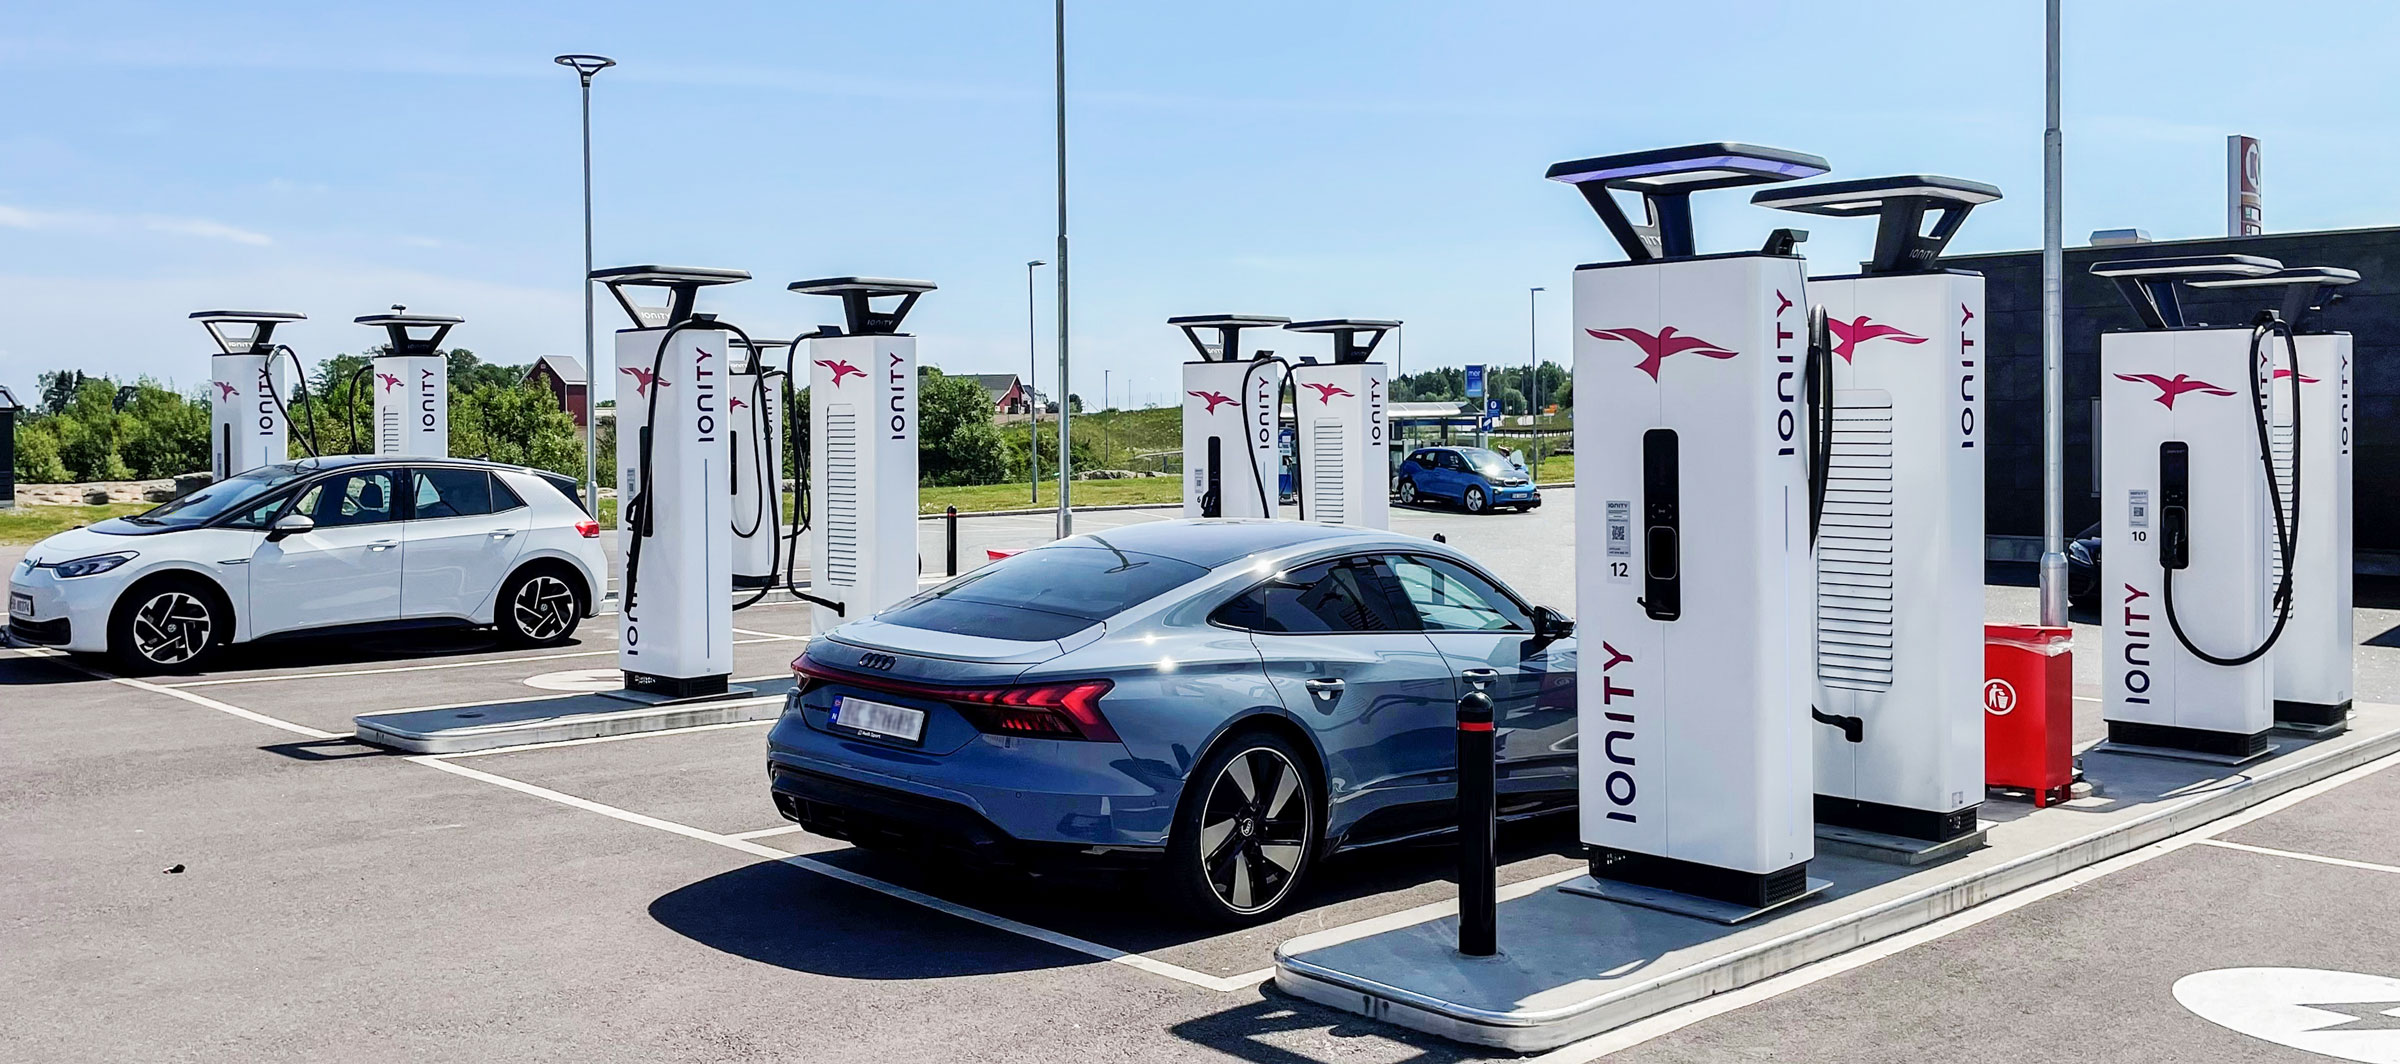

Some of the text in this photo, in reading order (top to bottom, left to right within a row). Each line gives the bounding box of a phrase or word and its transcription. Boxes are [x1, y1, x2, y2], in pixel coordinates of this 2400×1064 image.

[422, 368, 435, 432] IONITY
[696, 346, 715, 443] IONITY
[890, 351, 906, 441] IONITY
[1259, 375, 1270, 449] IONITY
[1370, 376, 1382, 446] IONITY
[1776, 288, 1796, 457] IONITY
[1961, 301, 1975, 448] IONITY
[1610, 562, 1629, 578] 12
[2131, 531, 2147, 542] 10
[2123, 581, 2151, 706] IONITY
[1602, 640, 1637, 825] IONITY
